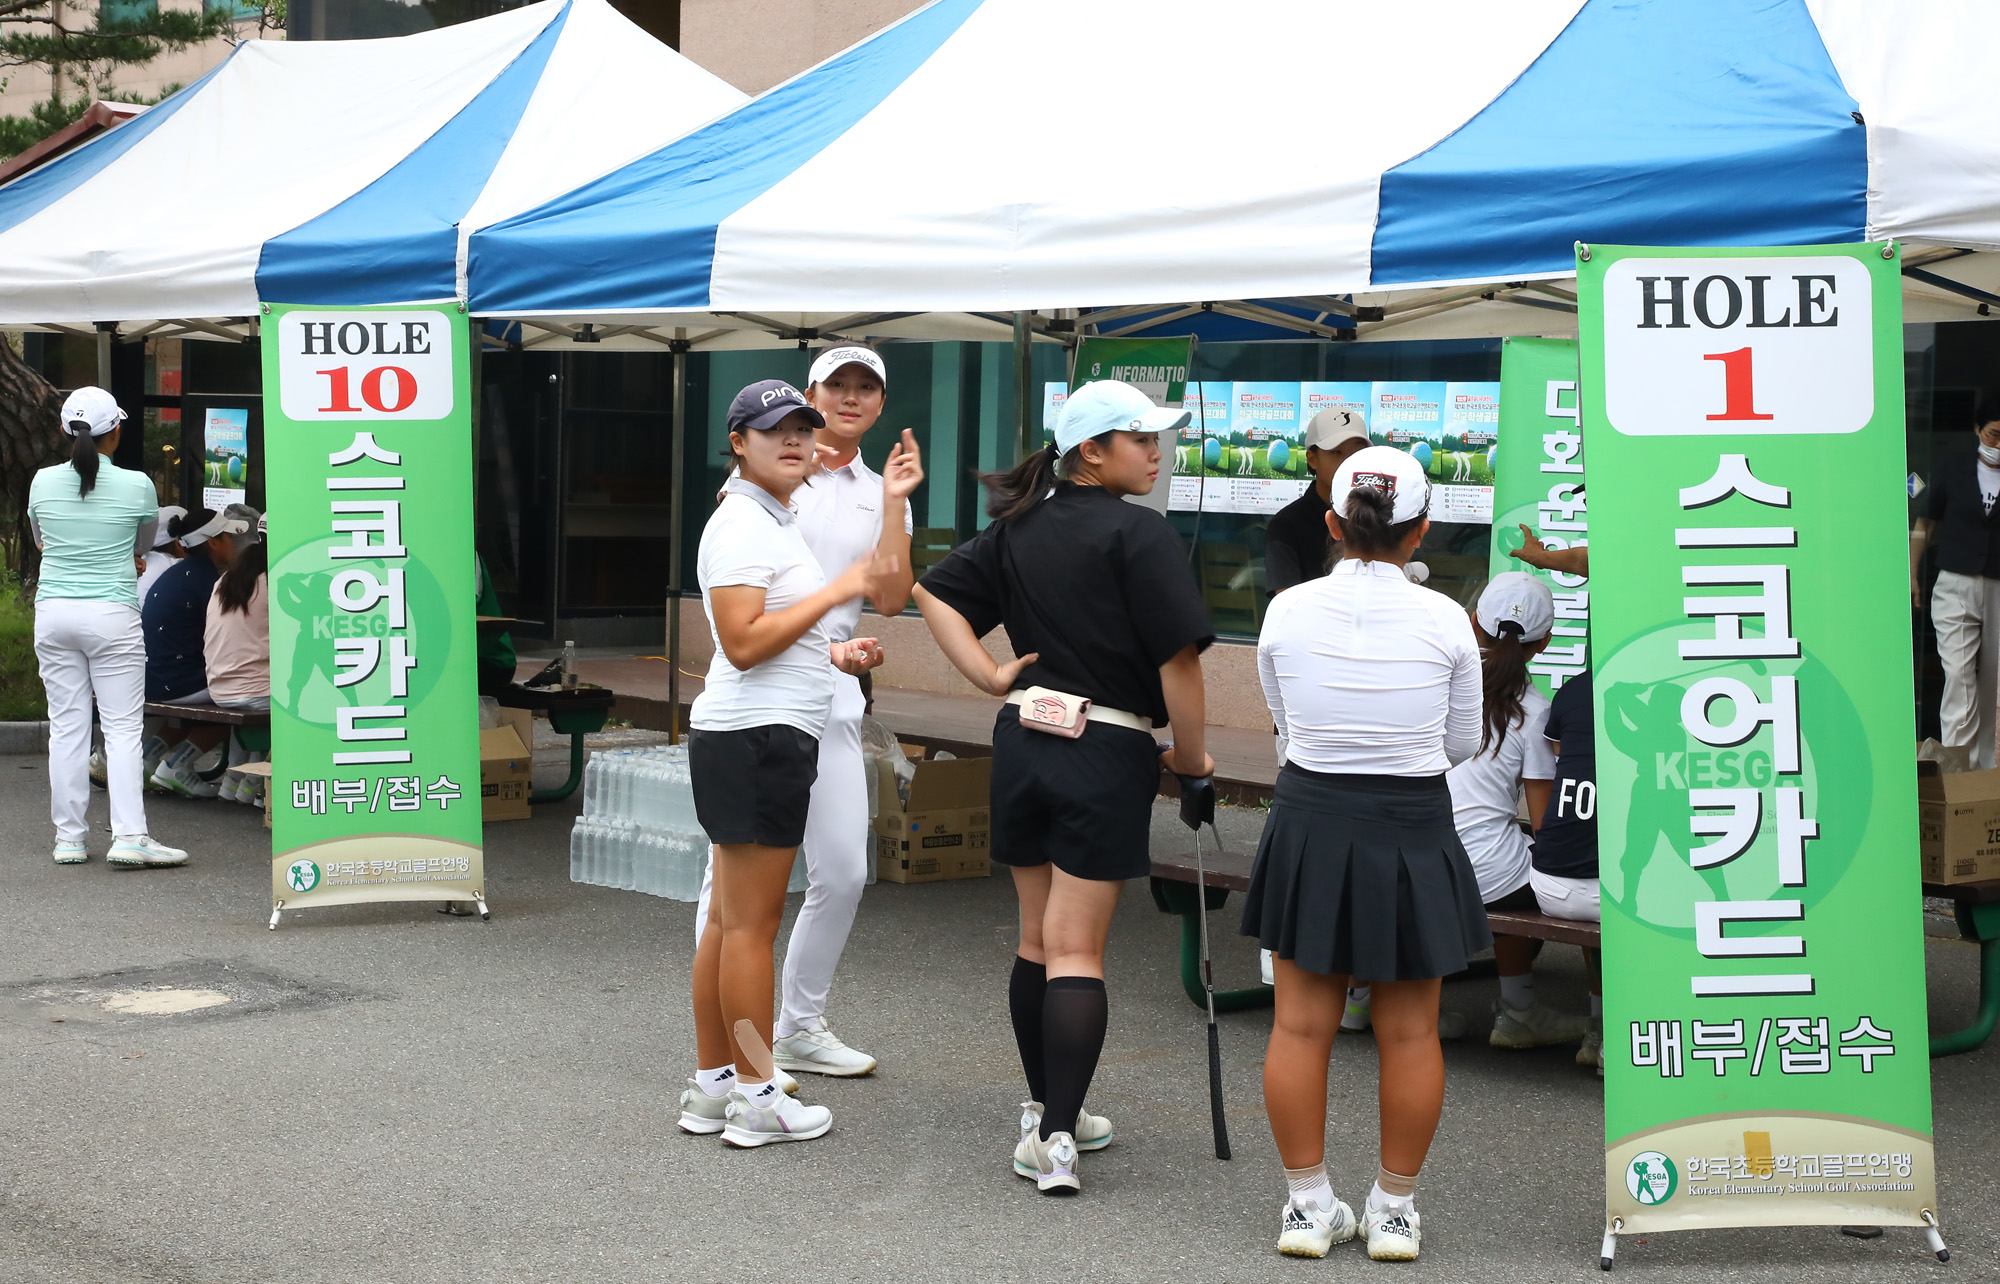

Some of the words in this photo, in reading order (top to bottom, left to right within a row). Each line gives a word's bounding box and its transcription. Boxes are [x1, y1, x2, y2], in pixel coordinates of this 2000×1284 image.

[1635, 274, 1839, 330] HOLE
[300, 321, 431, 356] HOLE
[828, 350, 876, 367] Titleist
[316, 366, 418, 413] 10
[1703, 346, 1775, 421] 1
[1239, 409, 1294, 420] 전국학생골프대회
[1379, 410, 1439, 422] 전국학생골프대회
[326, 432, 418, 766] 스코어카드
[1674, 454, 1819, 998] 스코어카드
[292, 775, 461, 815] 배부/접수
[326, 857, 471, 877] 한국초등학교골프연맹
[327, 878, 348, 887] Korea
[350, 877, 390, 886] Elementary
[391, 875, 414, 883] School
[415, 874, 431, 883] Golf
[432, 873, 471, 882] Association
[1630, 1016, 1896, 1077] 배부/접수
[1642, 1172, 1667, 1181] KESGA
[1685, 1153, 1913, 1181] 한국초등학교골프연맹
[1688, 1185, 1721, 1195] Korea
[1724, 1183, 1786, 1196] Elementary
[1788, 1182, 1824, 1193] School
[1826, 1181, 1851, 1193] Golf
[1853, 1180, 1915, 1192] Association
[1284, 1220, 1314, 1232] adidas
[1380, 1224, 1413, 1239] adidas
